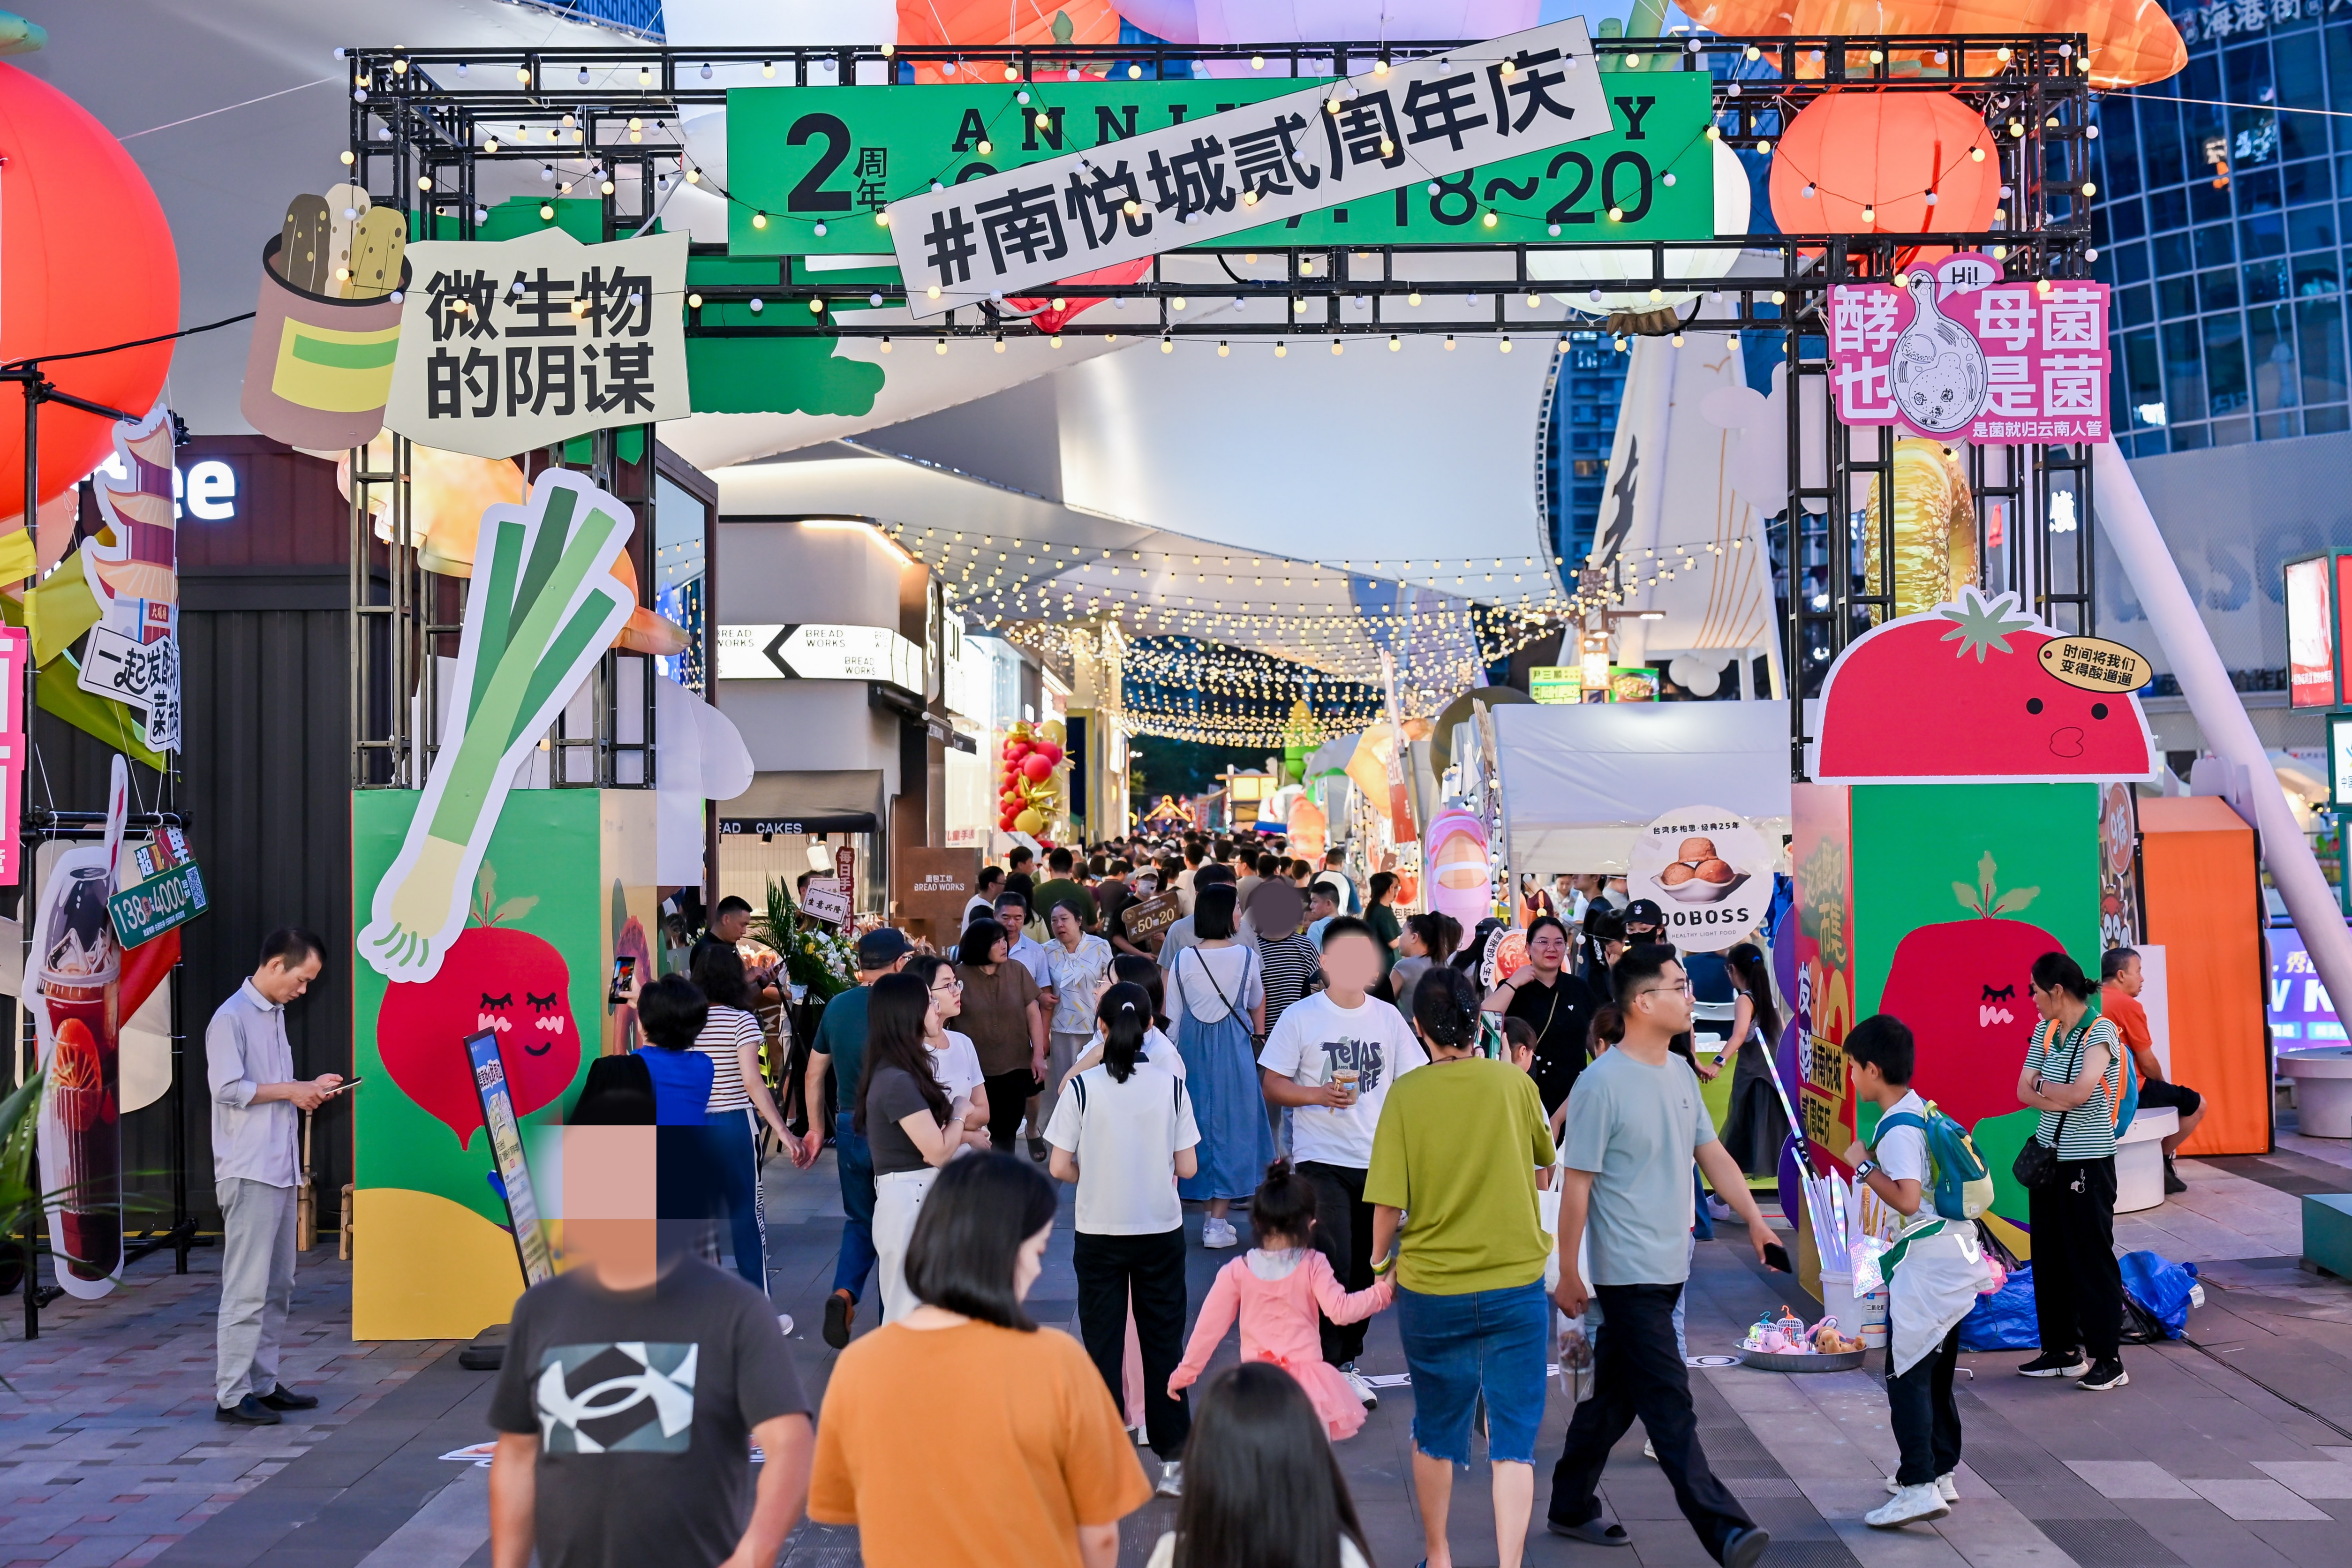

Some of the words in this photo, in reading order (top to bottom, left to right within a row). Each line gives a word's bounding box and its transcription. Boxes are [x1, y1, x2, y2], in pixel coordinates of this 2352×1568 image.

[786, 113, 852, 212] 2
[1952, 266, 1978, 286] Hi!
[425, 266, 652, 341] 微生物
[427, 342, 656, 419] 的阴谋
[1972, 420, 2102, 438] 是菌就归云南人管
[807, 639, 845, 648] WORKS
[845, 656, 874, 665] BREAD
[2063, 644, 2136, 671] 时间将我们
[845, 666, 876, 675] WORKS
[2059, 659, 2133, 686] 变得酸遛遛
[756, 822, 802, 834] CAKES
[1653, 822, 1740, 835] 台湾多柏思·经典25年
[114, 895, 147, 933] 138
[807, 897, 842, 914] 生意兴隆
[1812, 1042, 1842, 1094] #南悦城
